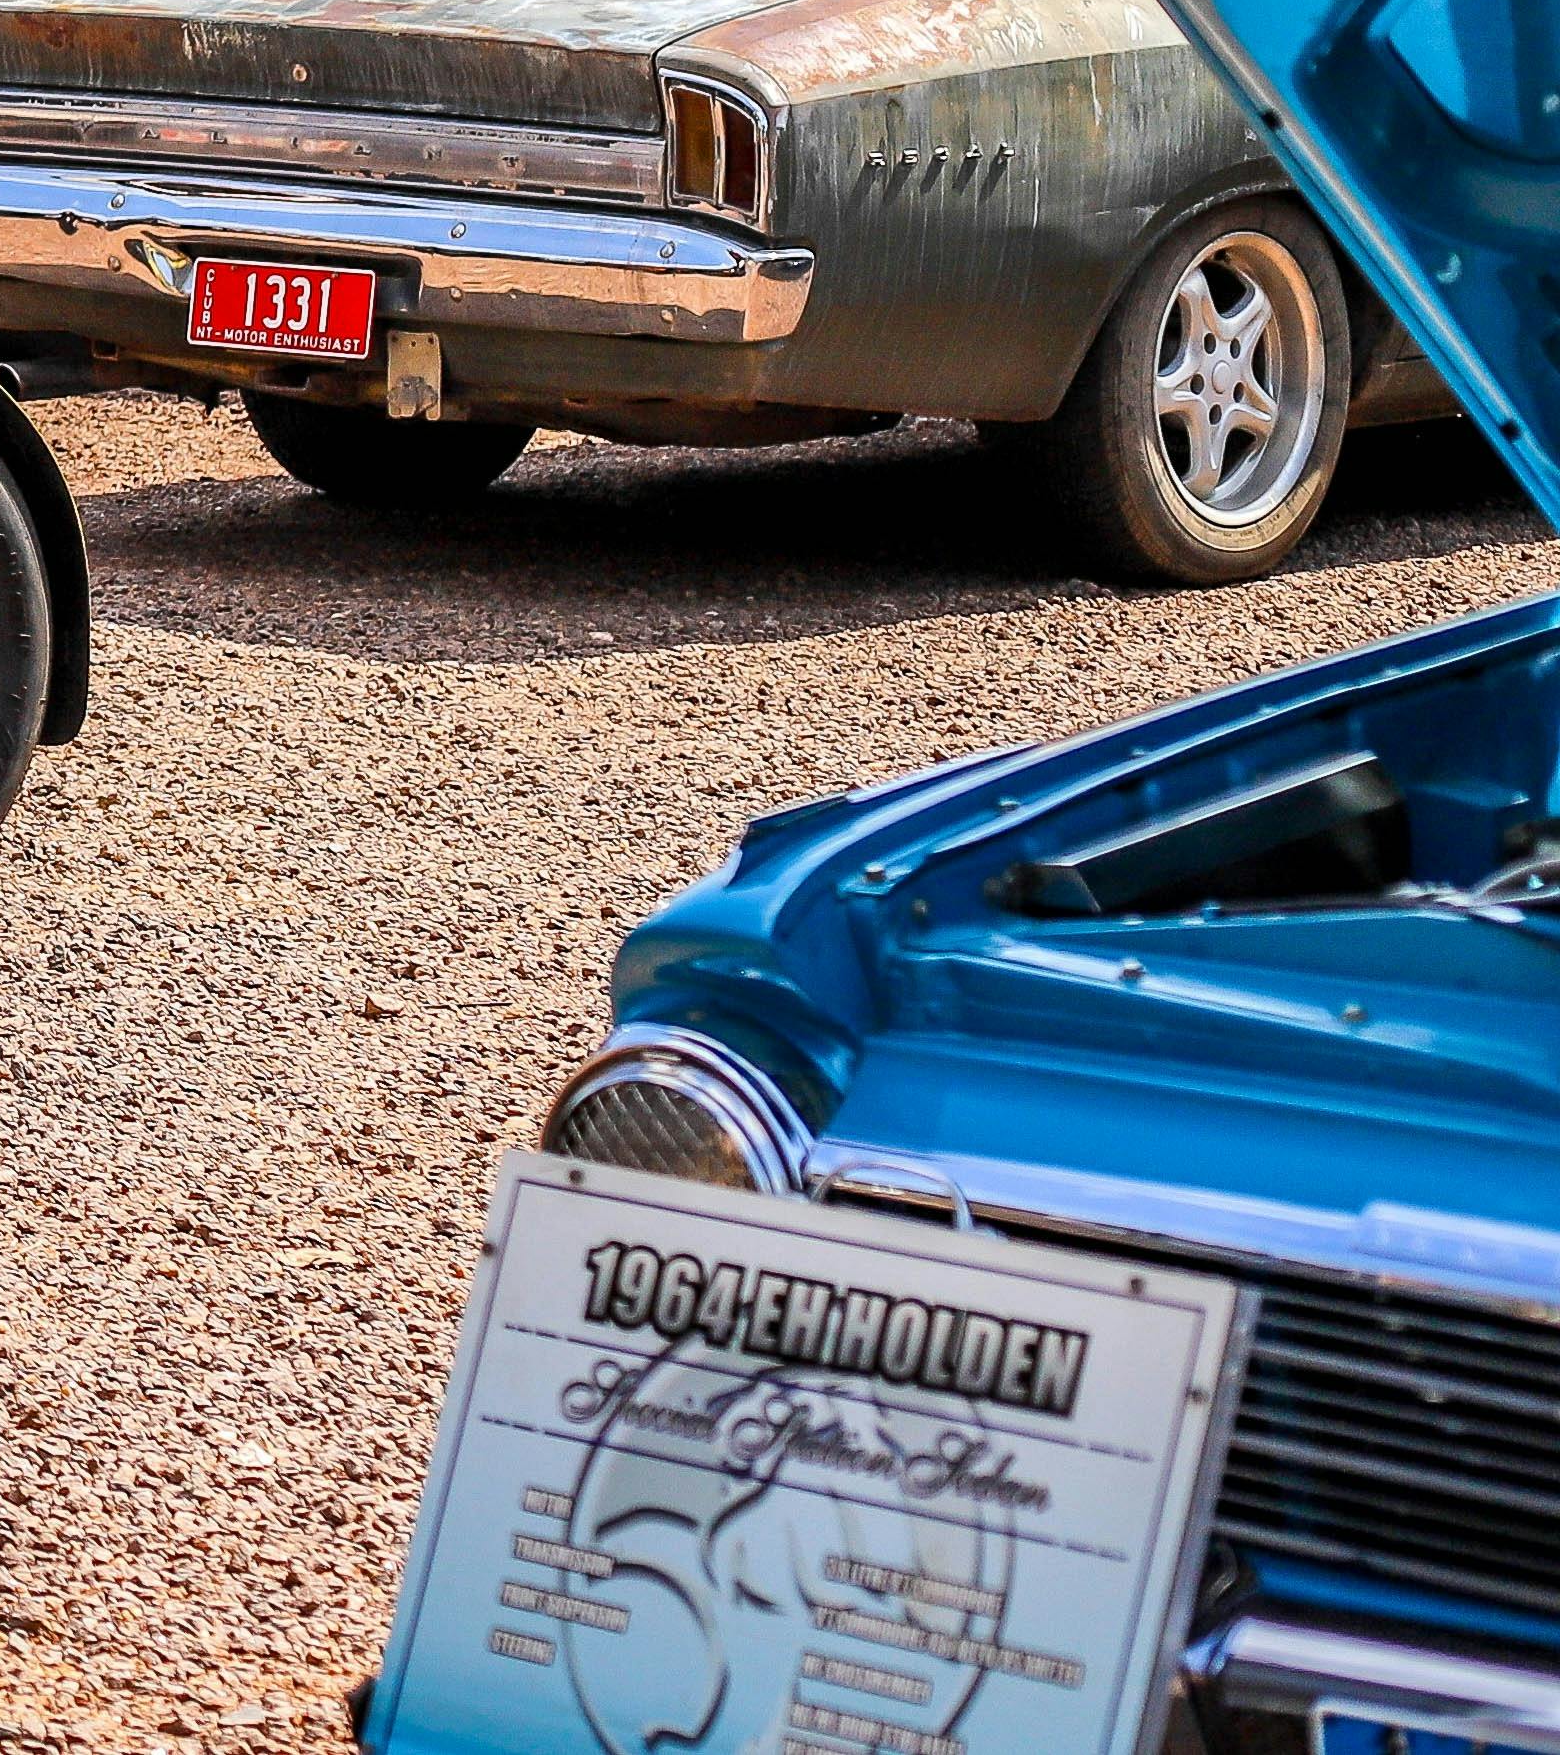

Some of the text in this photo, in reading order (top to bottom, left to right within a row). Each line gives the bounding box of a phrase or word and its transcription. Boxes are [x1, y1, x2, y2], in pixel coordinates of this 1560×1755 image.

[201, 268, 216, 325] CLUB
[244, 272, 331, 333] 1331
[273, 332, 361, 353] ENTHUSIAST
[584, 1241, 1090, 1421] 1964 EH HOLDEN
